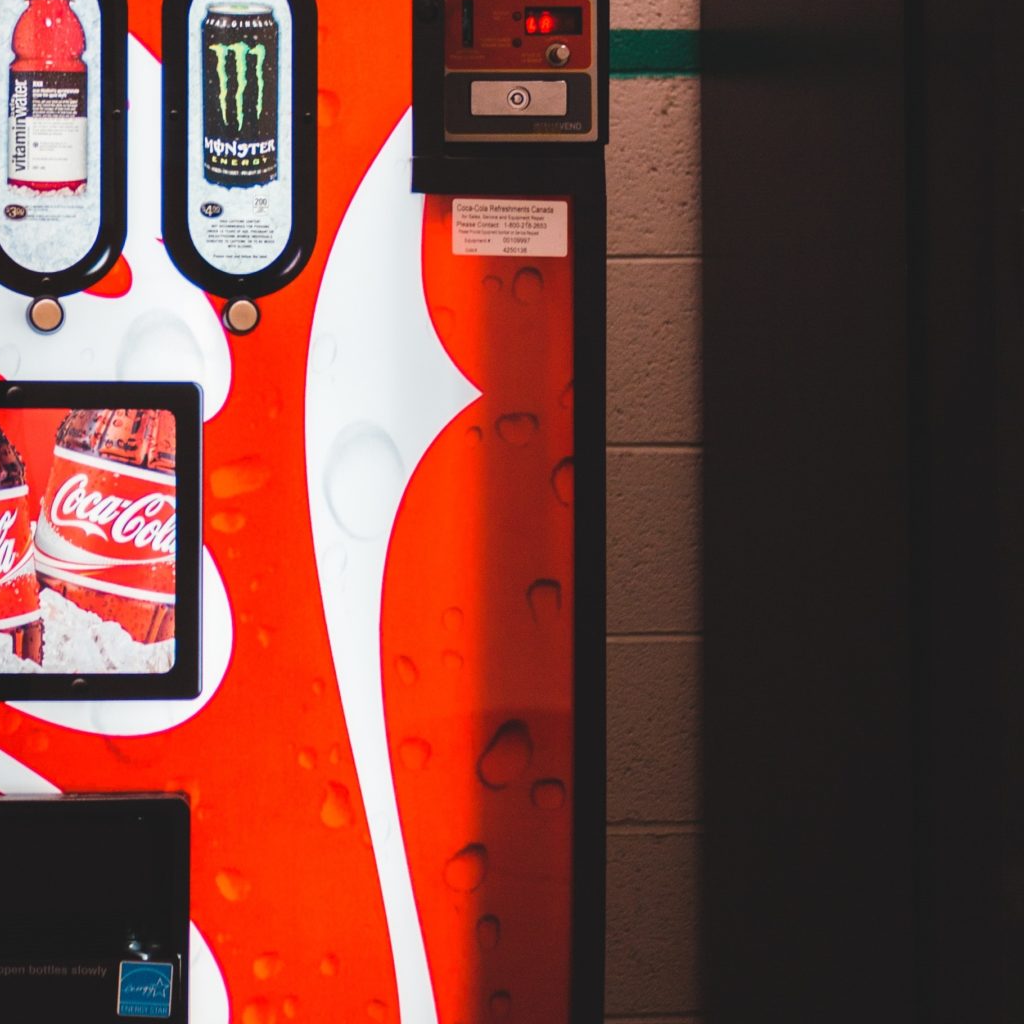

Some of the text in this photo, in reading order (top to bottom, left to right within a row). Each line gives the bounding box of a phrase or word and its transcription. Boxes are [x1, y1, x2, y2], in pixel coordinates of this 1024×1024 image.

[12, 79, 28, 172] vitaminwater
[204, 137, 276, 158] MONSTER
[212, 155, 268, 166] ENERGY
[456, 204, 554, 214] Coca-Cola Refreshments Canada
[29, 964, 68, 975] bottles
[71, 964, 108, 977] slowly
